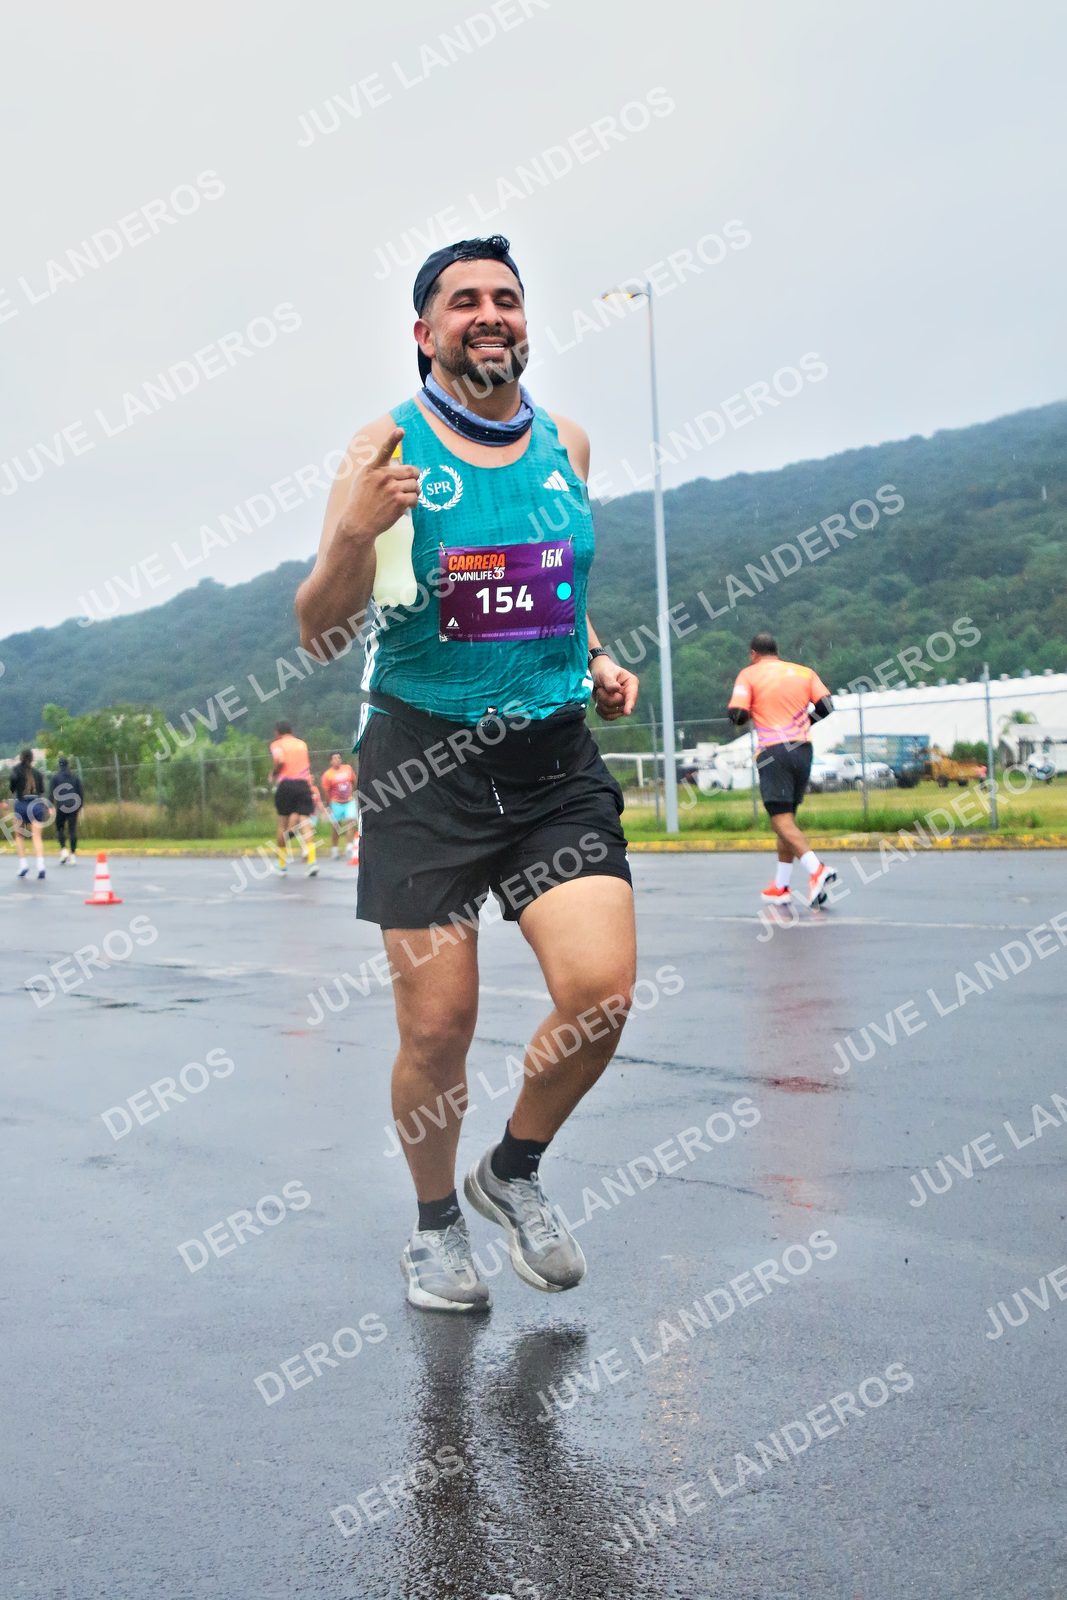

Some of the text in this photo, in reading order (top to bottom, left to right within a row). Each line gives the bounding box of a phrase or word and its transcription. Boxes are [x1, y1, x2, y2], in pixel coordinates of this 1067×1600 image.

[425, 480, 453, 496] SPR
[448, 553, 506, 570] CARRERA
[541, 548, 564, 568] 15K
[476, 585, 534, 614] 154
